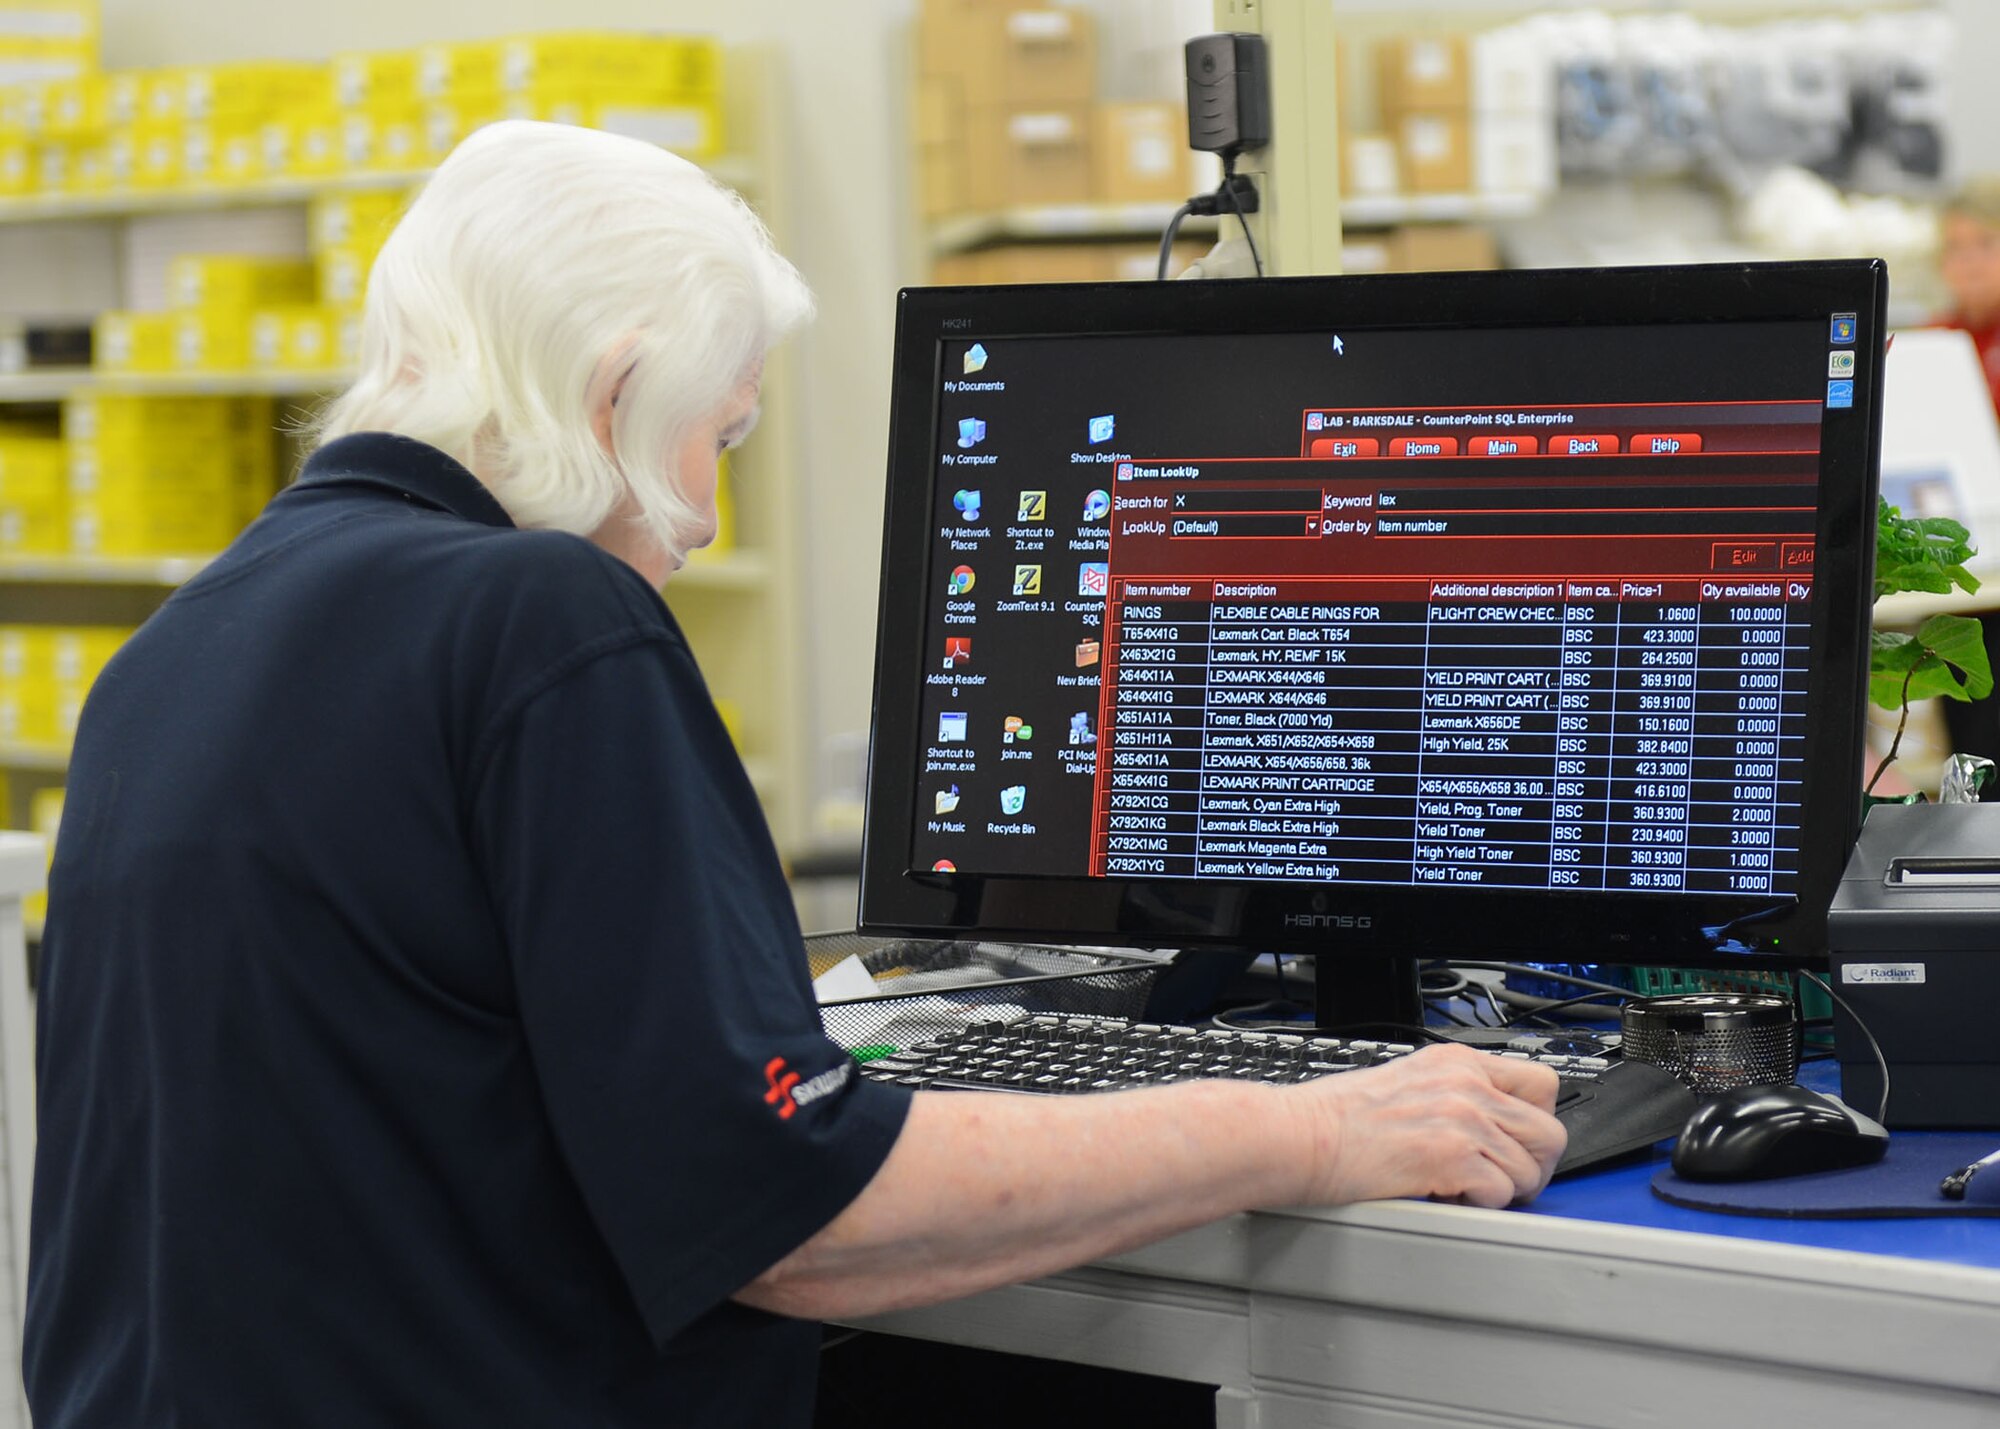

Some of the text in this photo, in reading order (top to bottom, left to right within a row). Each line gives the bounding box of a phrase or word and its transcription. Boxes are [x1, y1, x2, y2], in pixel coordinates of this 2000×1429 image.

[942, 319, 972, 328] HK241
[944, 381, 1004, 392] My Documents
[1323, 414, 1573, 427] LAB BARKSDALE CounterPoint SQL Enterprise
[1334, 443, 1356, 456] Exit
[1406, 442, 1440, 455] Home
[1488, 441, 1517, 454] Main
[1569, 439, 1599, 454] Back
[1652, 438, 1679, 453] Help
[942, 454, 998, 465] My Computer
[1071, 453, 1094, 463] Show
[1134, 467, 1199, 479] Item LookUp
[1115, 496, 1168, 510] Search for
[1176, 496, 1185, 507] X
[1324, 495, 1372, 509] Keyword
[1380, 493, 1396, 505] lex
[1123, 521, 1165, 535] LookUp
[1173, 521, 1218, 534] (Default)
[1323, 520, 1371, 534] Order by
[1379, 520, 1447, 532] Item number
[941, 527, 990, 538] My Network
[1007, 528, 1054, 537] Shortcut to
[951, 540, 977, 550] Places
[1015, 540, 1043, 550] Zt.exe
[1069, 540, 1109, 549] Media Pla
[1125, 585, 1190, 596] Item number
[1215, 585, 1276, 598] Description
[1432, 584, 1562, 598] Additional description 1
[1569, 585, 1592, 596] Item
[1623, 584, 1662, 596] Price-1
[1703, 584, 1781, 599] Qty available
[1789, 584, 1810, 599] Qty
[947, 601, 975, 612] Google
[997, 602, 1054, 611] ZoomText 9.1
[1124, 607, 1161, 618] RINGS
[945, 614, 976, 623] Chrome
[1214, 607, 1379, 620] FLEXIBLE CABLE RINGS FOR
[1431, 607, 1518, 620] FLIGHT CREW
[1567, 608, 1594, 620] BSC
[1658, 608, 1695, 621] 1.0600
[1730, 608, 1781, 621] 100.0000
[1083, 615, 1100, 626] SQL
[1123, 628, 1178, 639] T654X41G
[1212, 628, 1350, 640] Lexmark Black T654
[1643, 630, 1694, 643] 423.3000
[1743, 631, 1780, 643] 0.0000
[1121, 649, 1175, 660] X463X21G
[1262, 650, 1282, 662] HY,
[1285, 650, 1320, 662] REMF
[1325, 650, 1346, 662] 15K
[1565, 652, 1592, 664] BSC
[1642, 652, 1693, 665] 264.2500
[927, 675, 986, 684] Adobe Reader
[1057, 676, 1076, 685] New
[1119, 670, 1174, 681] X644X11A
[1427, 673, 1543, 685] YIELD PRINT CART
[1641, 674, 1691, 687] 369.9100
[952, 688, 958, 697] 8
[1118, 691, 1173, 703] X644X41G
[1117, 712, 1172, 724] X651A11A
[1208, 713, 1242, 725] Toner,
[1245, 714, 1276, 725] Black
[1278, 714, 1307, 727] (7000
[1425, 716, 1521, 728] Lexmark X656DE
[1561, 717, 1588, 730] BSC
[1639, 719, 1689, 731] 150.1600
[1738, 720, 1775, 732] 0.0000
[1115, 733, 1171, 745] X651H11A
[1256, 735, 1375, 748] X651/X652/X654-X658
[1423, 738, 1509, 752] High Yield, 25K
[928, 748, 974, 758] Shortcut to
[1637, 741, 1688, 753] 382.8400
[1001, 750, 1032, 760] join.me
[1058, 750, 1073, 760] PCI
[1114, 754, 1169, 766] X654X11A
[926, 761, 975, 771] join.me.exe
[1636, 763, 1687, 775] 423.3000
[1113, 775, 1168, 787] X654X41G
[1203, 777, 1375, 791] LEXMARK PRINT CARTRIDGE
[1420, 781, 1510, 795] X654/X656/X658
[1557, 783, 1584, 795] BSC
[1635, 785, 1685, 798] 416.6100
[1734, 786, 1772, 799] 0.0000
[1111, 796, 1168, 808] X792X1CG
[1254, 798, 1281, 813] Cyan
[1284, 799, 1312, 811] Extra
[1314, 800, 1340, 814] High
[1420, 803, 1522, 818] Yield, Prog. Toner
[1634, 807, 1684, 820] 360.9300
[1733, 809, 1771, 821] 2.0000
[928, 822, 965, 833] My Music
[1110, 817, 1166, 829] X792X1KG
[988, 824, 1035, 835] Recycle Bin
[1632, 829, 1683, 842] 230.9400
[1732, 831, 1769, 844] 3.0000
[1109, 838, 1167, 850] X792X1MG
[1199, 840, 1327, 856] Lexmark Magenta Extra
[1553, 849, 1580, 862] BSC
[1731, 854, 1768, 866] 1.0000
[1108, 859, 1164, 871] X792X1YG
[1870, 969, 1916, 977] Radiant
